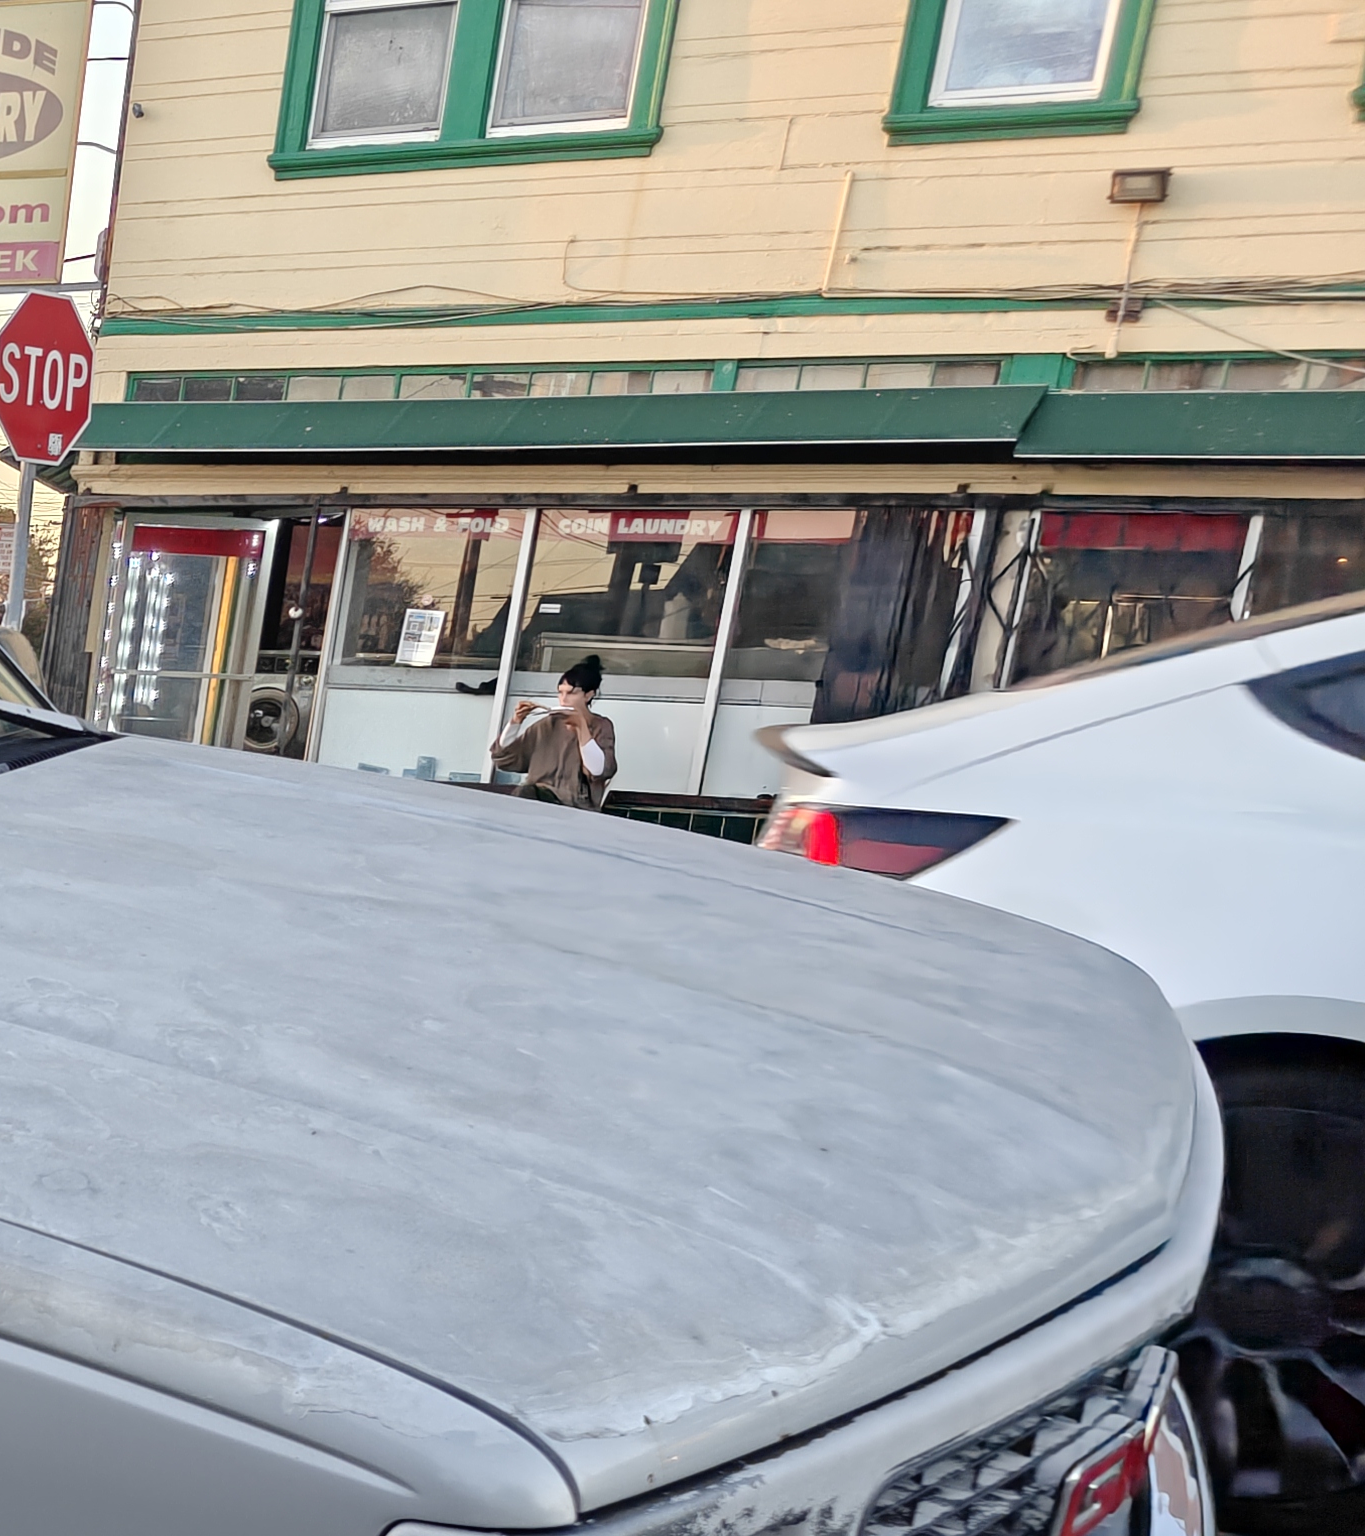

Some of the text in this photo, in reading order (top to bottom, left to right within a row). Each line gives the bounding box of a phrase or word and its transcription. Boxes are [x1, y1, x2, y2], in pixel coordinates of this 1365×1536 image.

[368, 516, 510, 533] WASH & FOLD
[558, 518, 723, 536] COIN LAUNDRY
